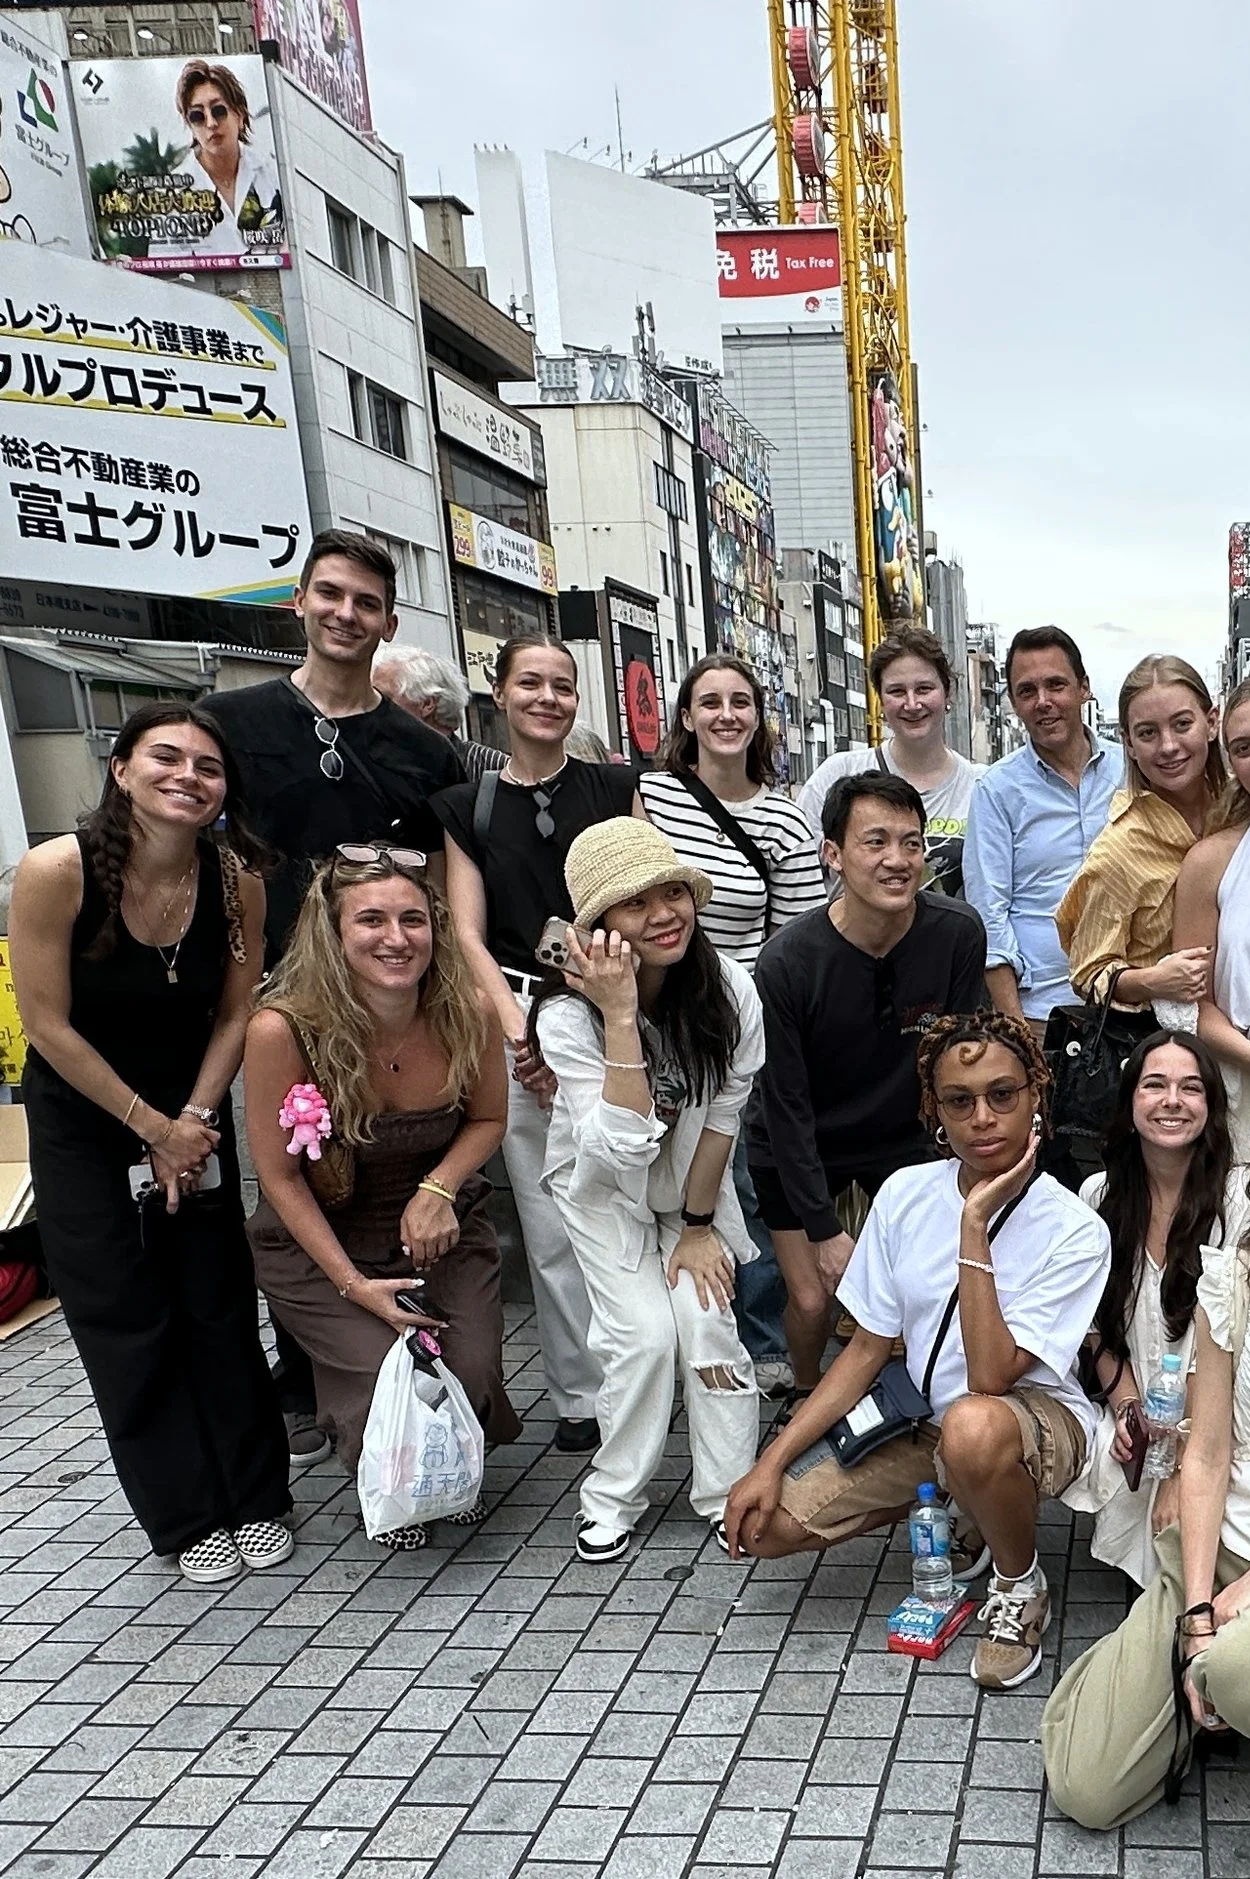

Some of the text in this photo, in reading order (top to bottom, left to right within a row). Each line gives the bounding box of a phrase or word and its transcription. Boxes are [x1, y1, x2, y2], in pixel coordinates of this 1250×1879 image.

[786, 256, 835, 270] Tax Free
[0, 298, 265, 364] レジャー・介護事業まで
[1, 434, 201, 497] 総合不動産業の
[9, 482, 301, 569] 富士グループ
